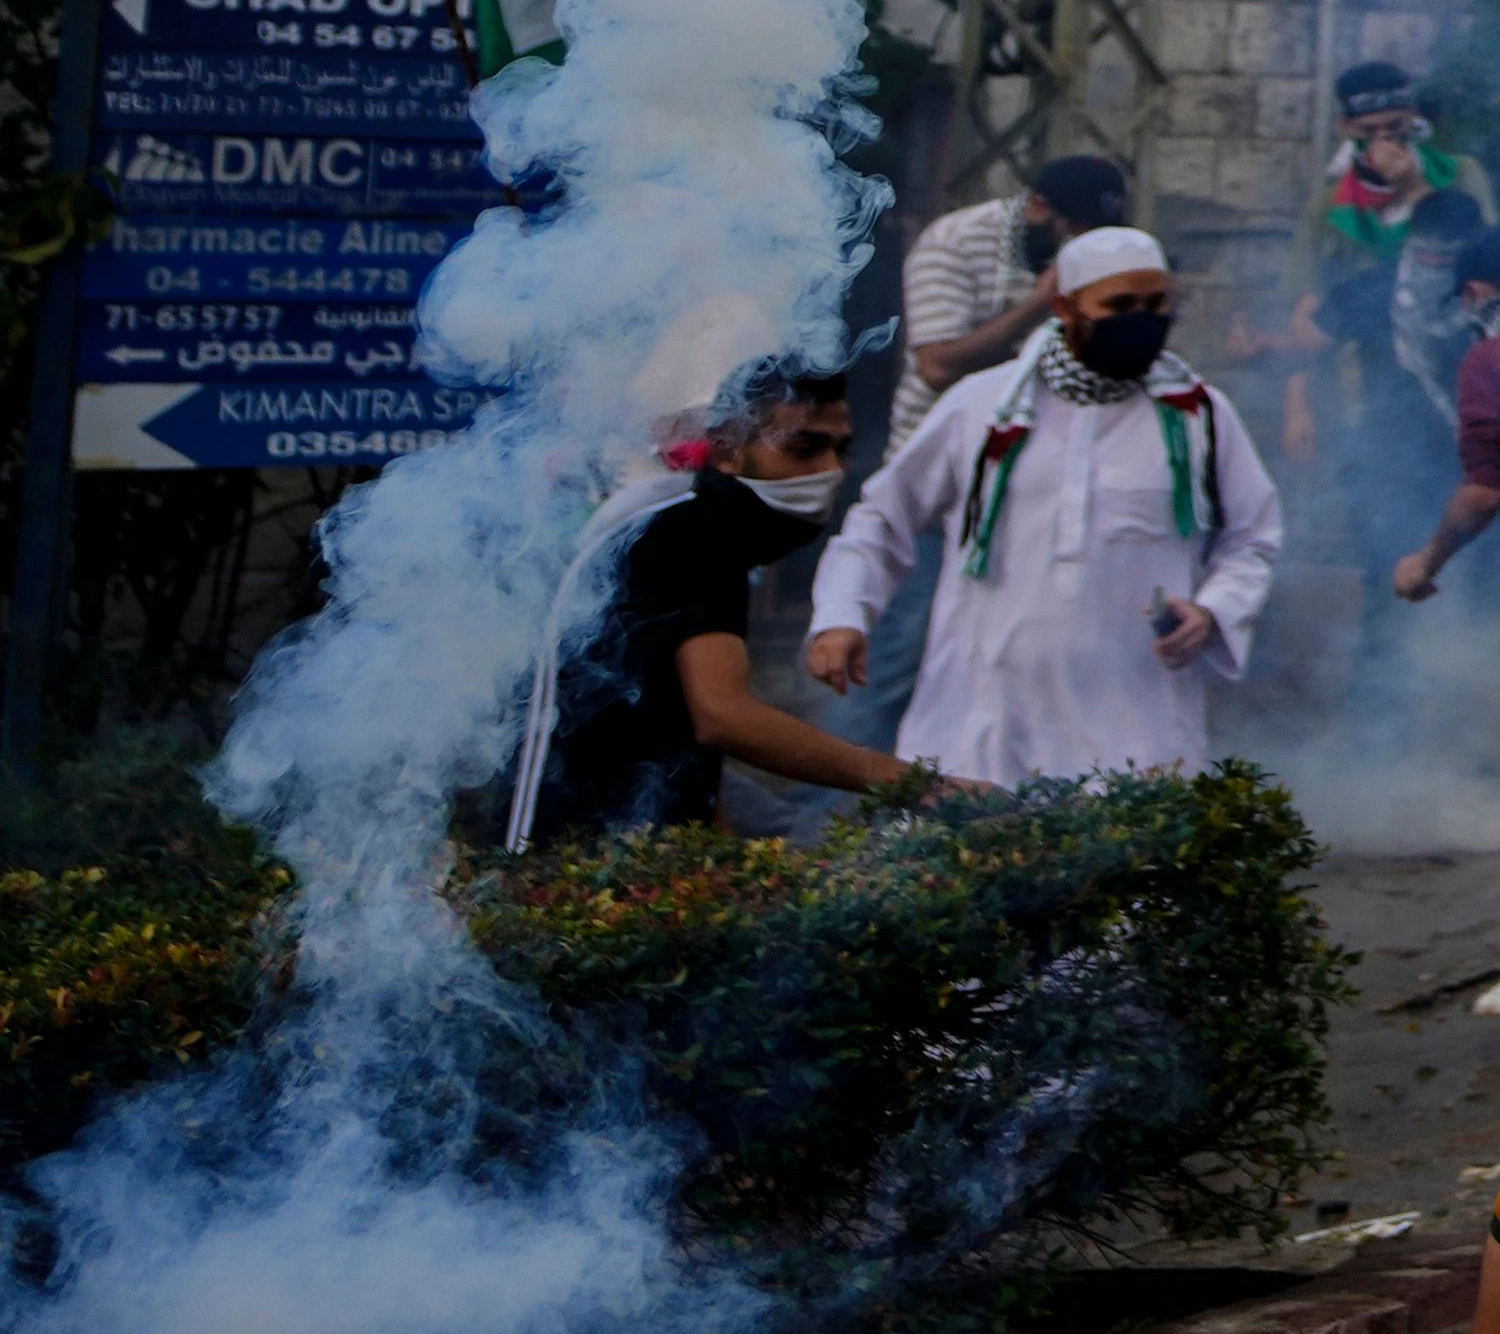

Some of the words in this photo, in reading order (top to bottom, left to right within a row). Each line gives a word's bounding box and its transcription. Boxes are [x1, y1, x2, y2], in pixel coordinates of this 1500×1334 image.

[256, 21, 301, 45] 04
[313, 22, 363, 47] 54
[372, 24, 422, 49] 67
[211, 135, 365, 187] DMC
[85, 219, 326, 256] harmacie
[337, 219, 449, 257] Aline
[145, 265, 202, 294] 04
[246, 267, 410, 295] 544478
[217, 387, 425, 425] KIMANTRA
